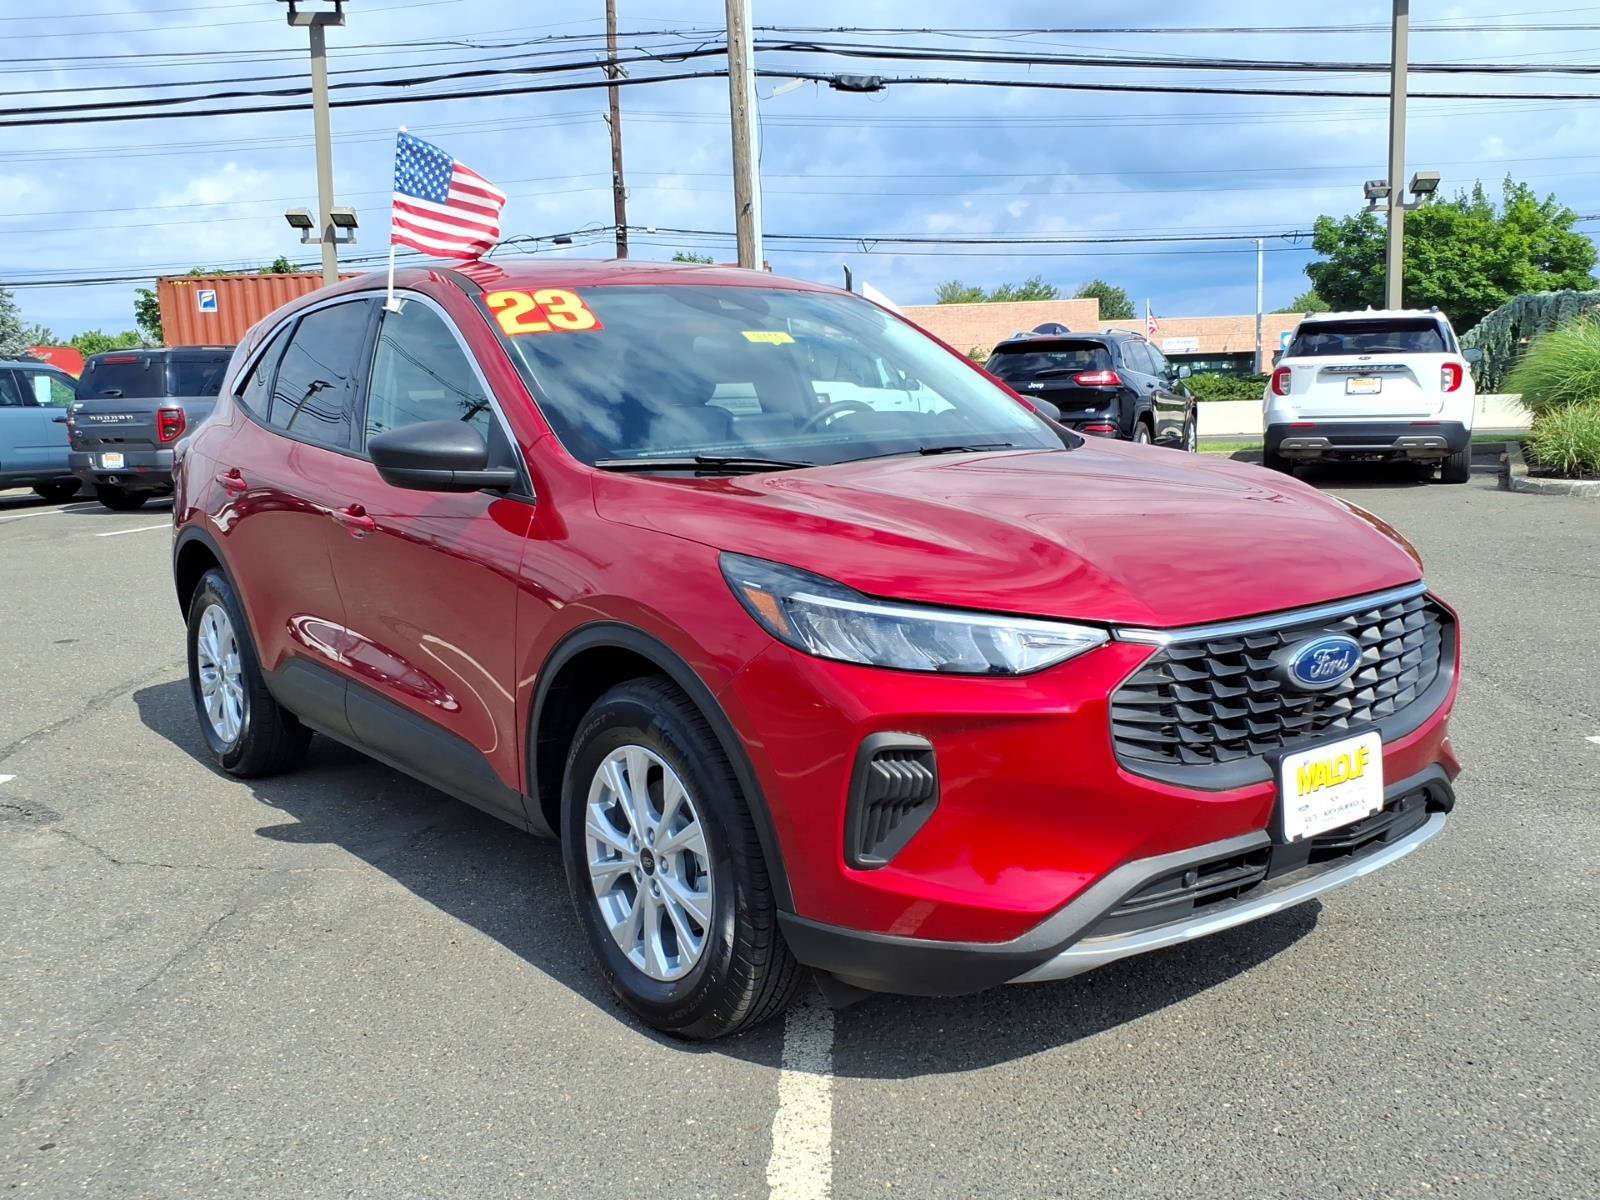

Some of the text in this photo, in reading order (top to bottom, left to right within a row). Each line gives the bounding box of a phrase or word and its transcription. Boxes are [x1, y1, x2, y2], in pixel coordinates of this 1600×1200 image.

[486, 289, 597, 335] 23
[1028, 382, 1045, 390] Jeep
[1310, 647, 1350, 678] Ford
[1297, 745, 1369, 796] MALOUF
